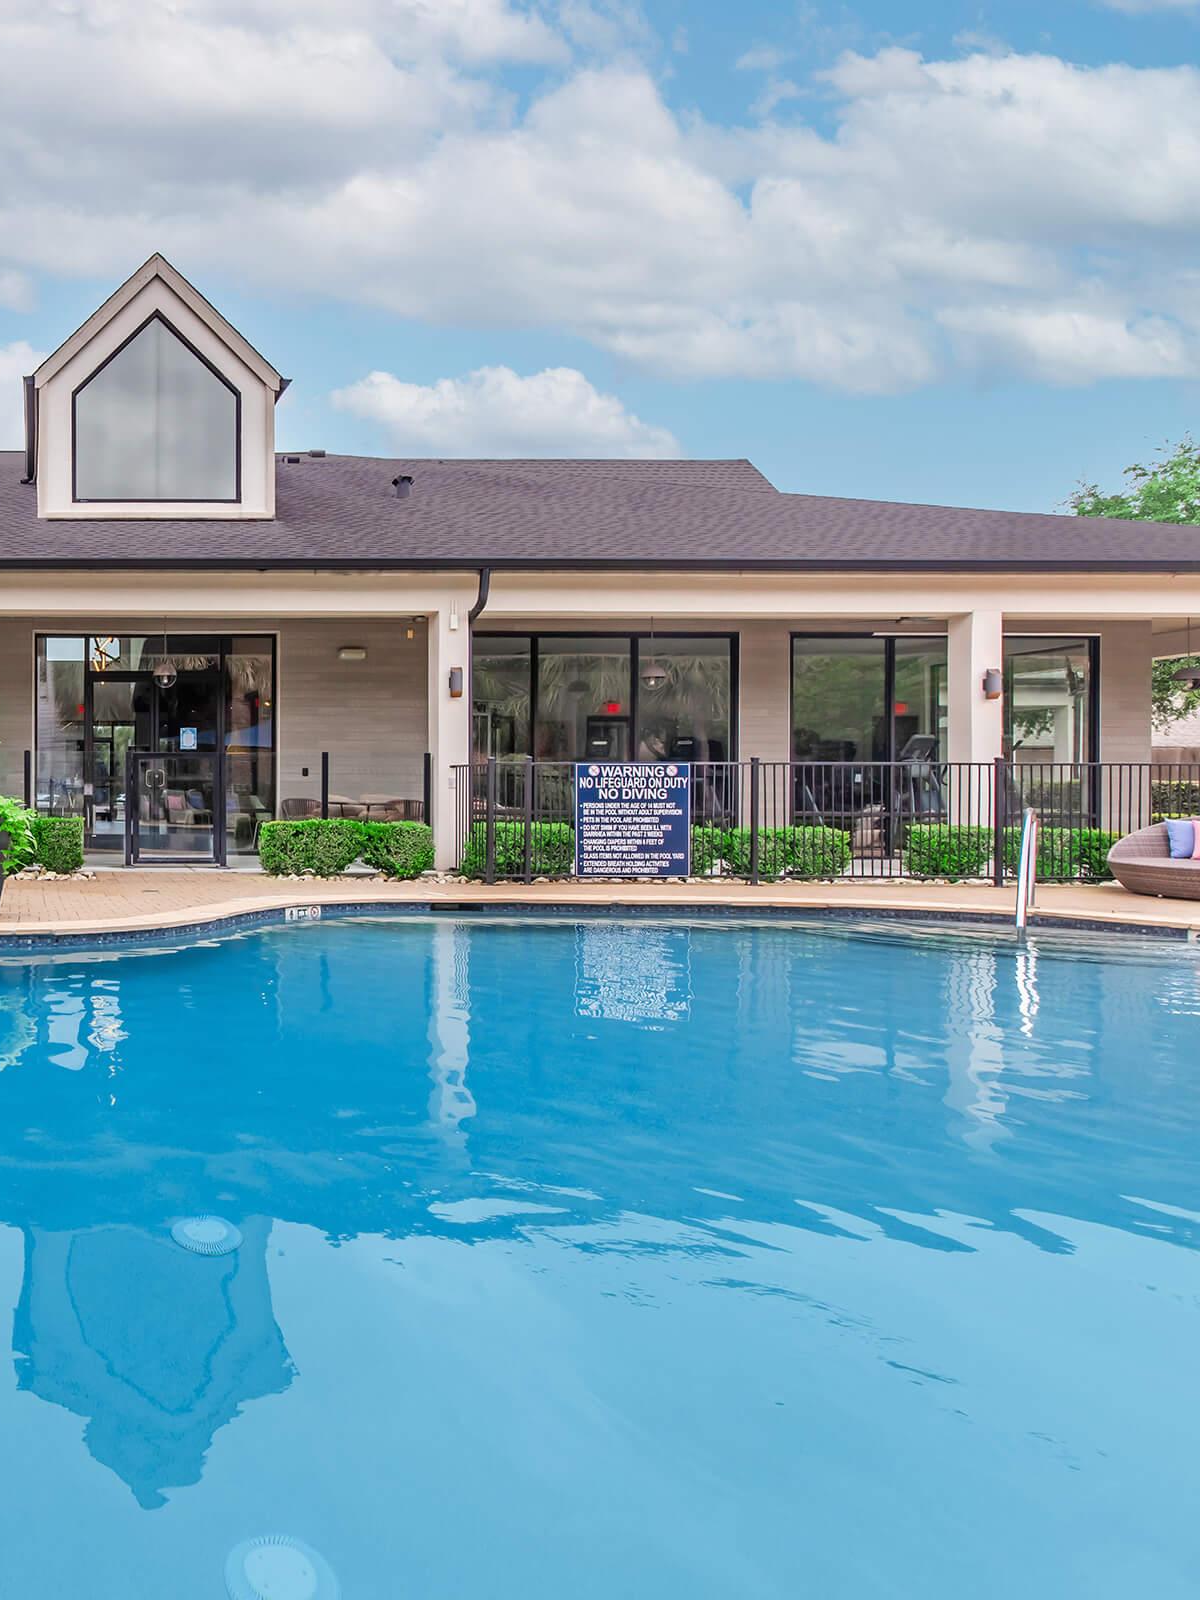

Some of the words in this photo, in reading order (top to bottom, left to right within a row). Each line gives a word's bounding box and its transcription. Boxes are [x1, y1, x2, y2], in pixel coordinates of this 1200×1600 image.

[601, 766, 665, 777] WARNING
[580, 777, 593, 788] NO
[595, 777, 646, 788] LIFEGUARD
[648, 777, 662, 788] ON
[664, 777, 688, 788] DUTY
[599, 789, 619, 799] NO
[622, 789, 668, 799] DIVING
